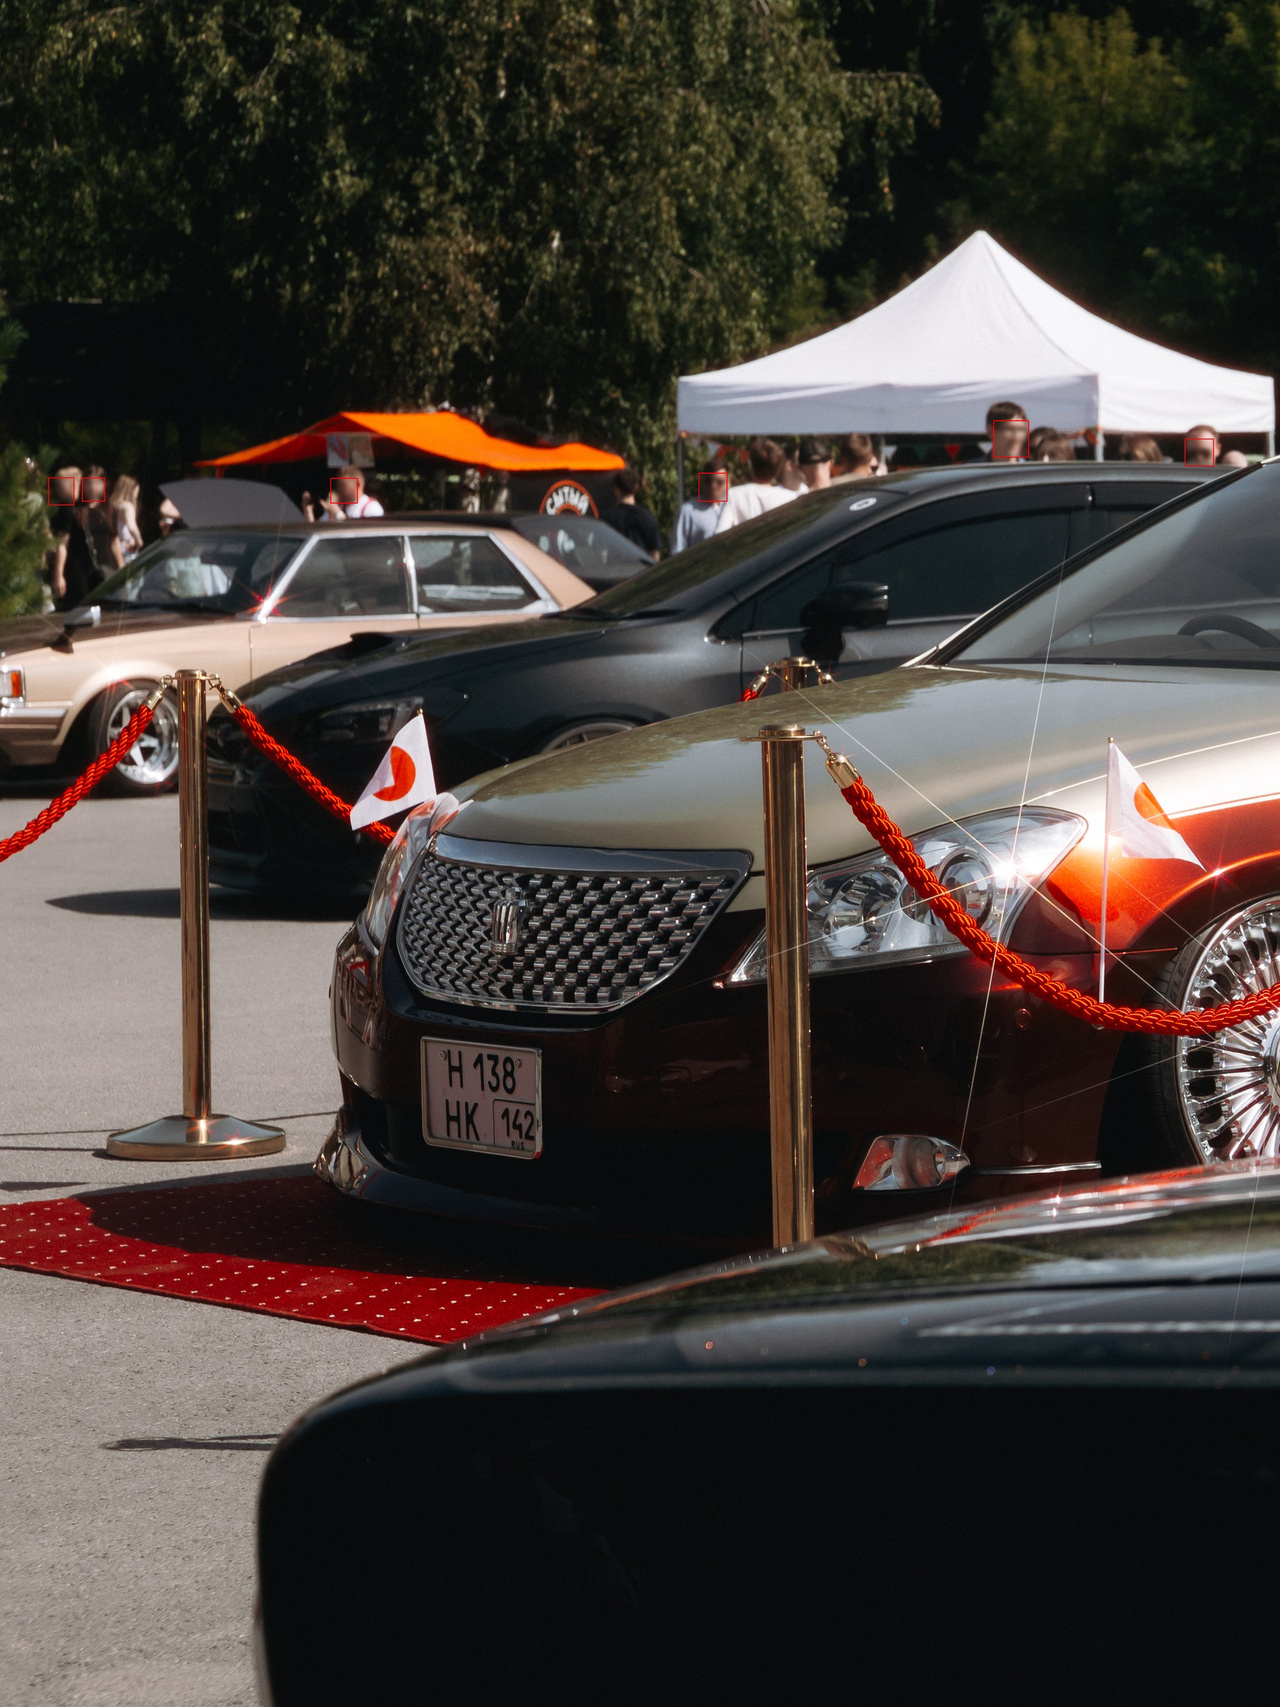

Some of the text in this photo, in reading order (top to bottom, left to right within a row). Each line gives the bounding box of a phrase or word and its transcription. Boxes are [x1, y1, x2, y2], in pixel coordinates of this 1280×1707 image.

[473, 1053, 516, 1094] 138
[501, 1107, 535, 1140] 142
[511, 1140, 525, 1151] RUS
